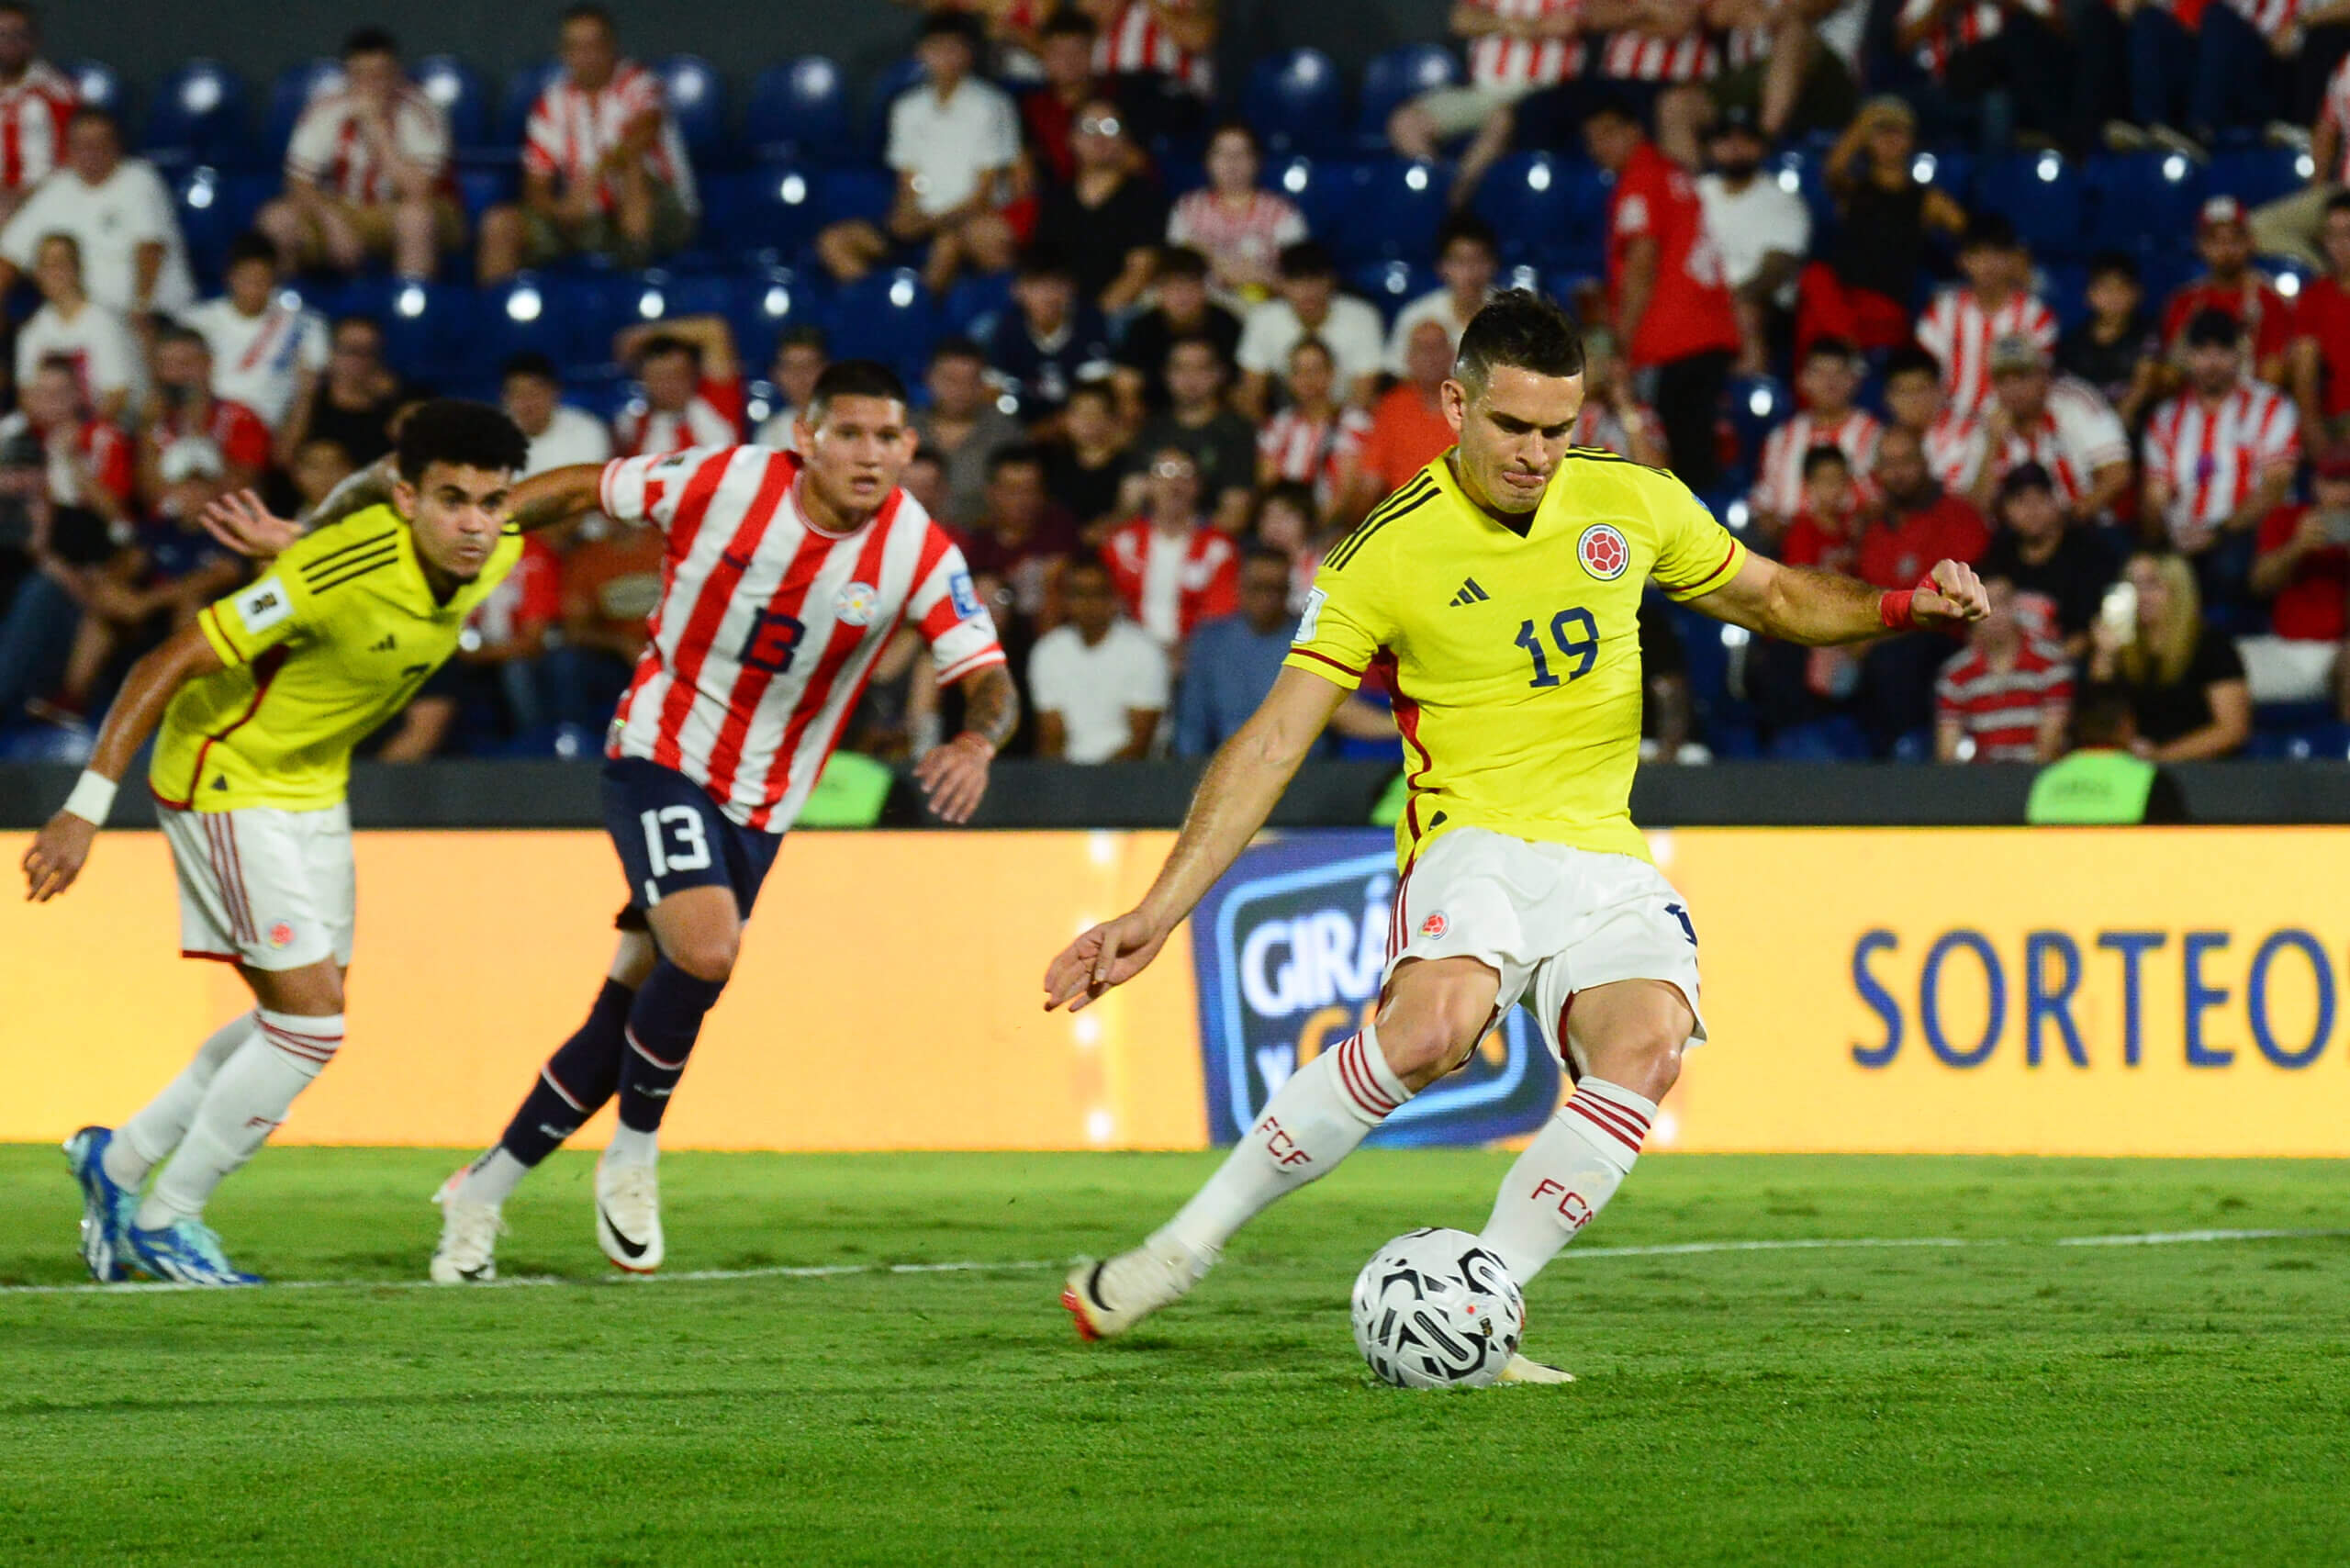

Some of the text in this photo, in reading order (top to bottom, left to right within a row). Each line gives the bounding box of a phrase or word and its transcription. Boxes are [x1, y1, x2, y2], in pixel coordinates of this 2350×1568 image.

[1515, 606, 1599, 688] 19
[641, 805, 711, 877] 13
[1852, 928, 2350, 1070] SORTEO
[1254, 1115, 1312, 1166] FCF
